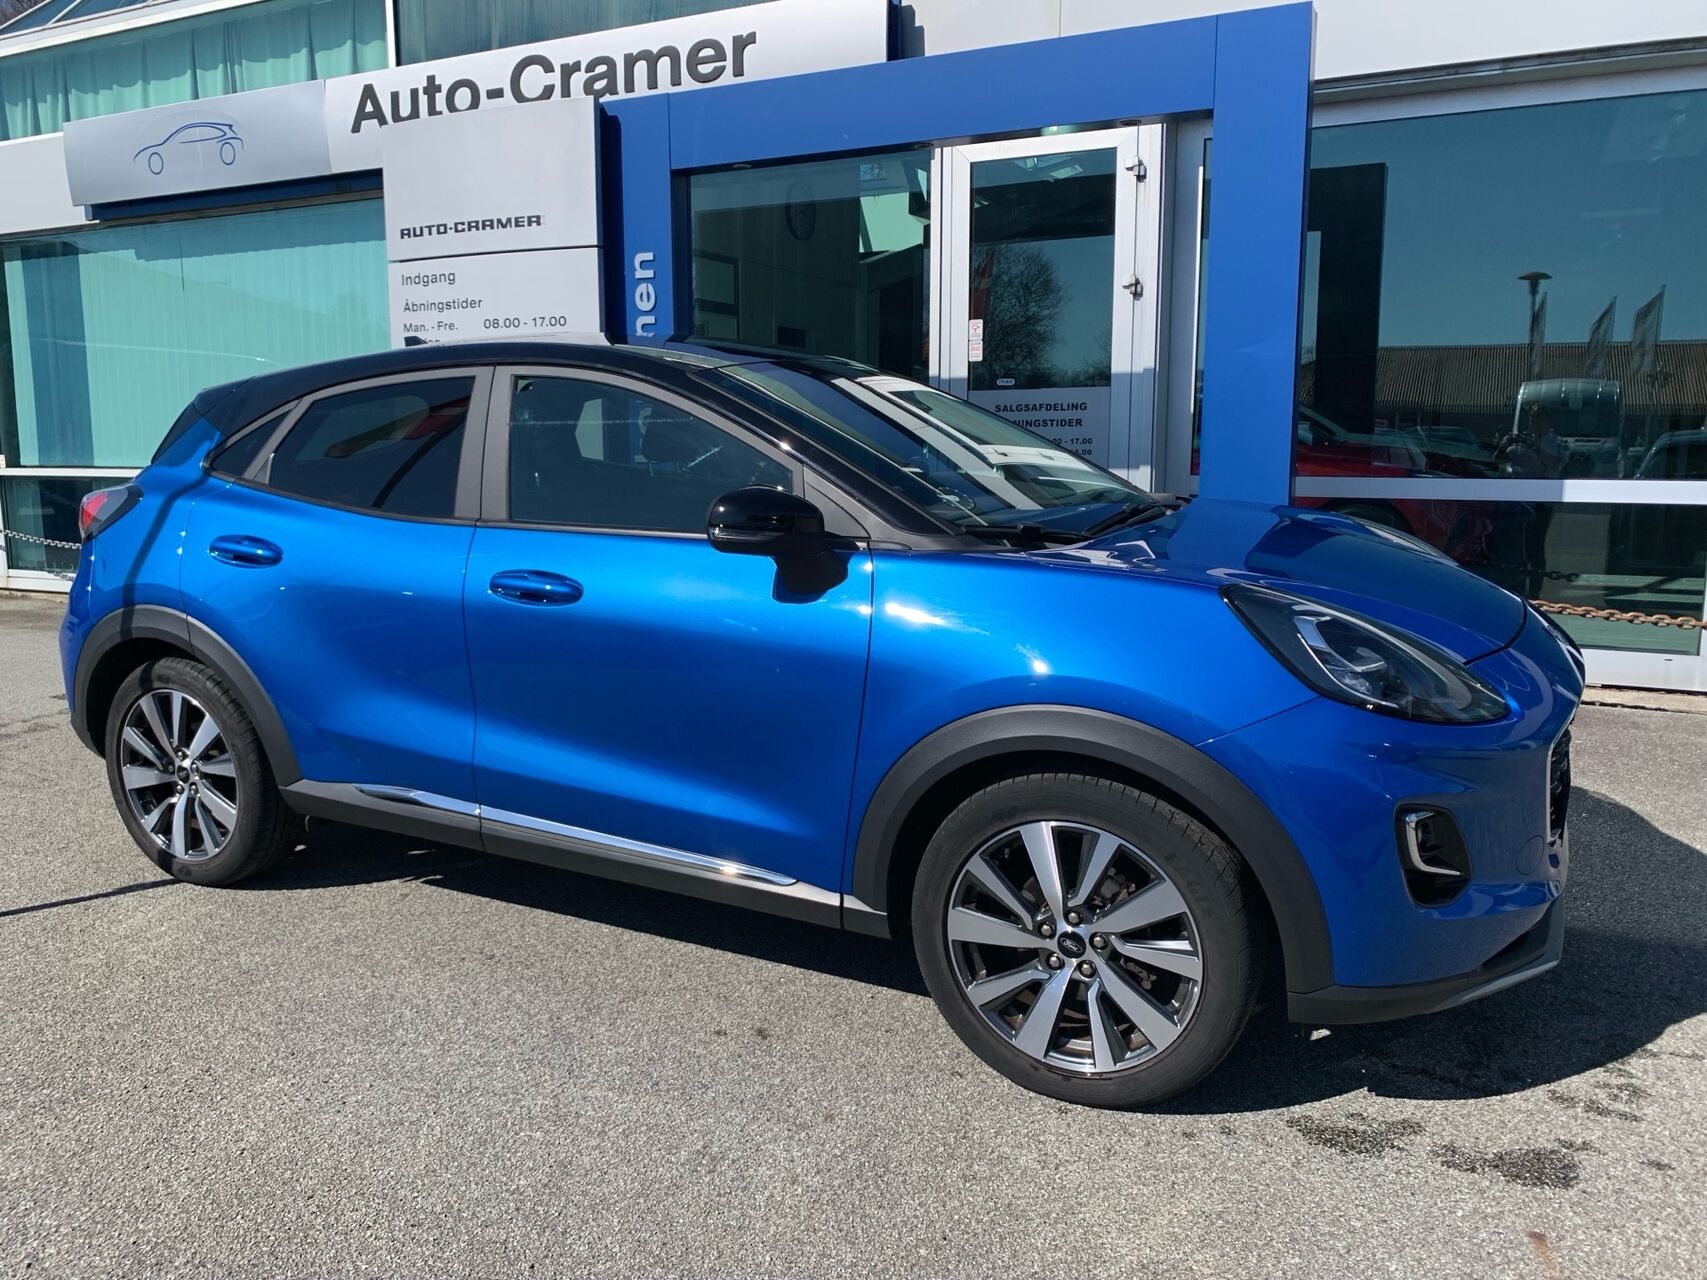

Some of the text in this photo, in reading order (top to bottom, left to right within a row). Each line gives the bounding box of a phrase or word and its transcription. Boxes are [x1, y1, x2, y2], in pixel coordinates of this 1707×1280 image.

[351, 31, 757, 133] Auto-Cramer
[401, 272, 456, 287] Indgang
[403, 297, 483, 313] Åbningstider
[403, 323, 429, 333] Man.
[437, 321, 458, 331] Fre.
[483, 317, 521, 329] 08.00
[531, 315, 567, 328] 17.00
[994, 402, 1088, 413] SALGSAFDELING
